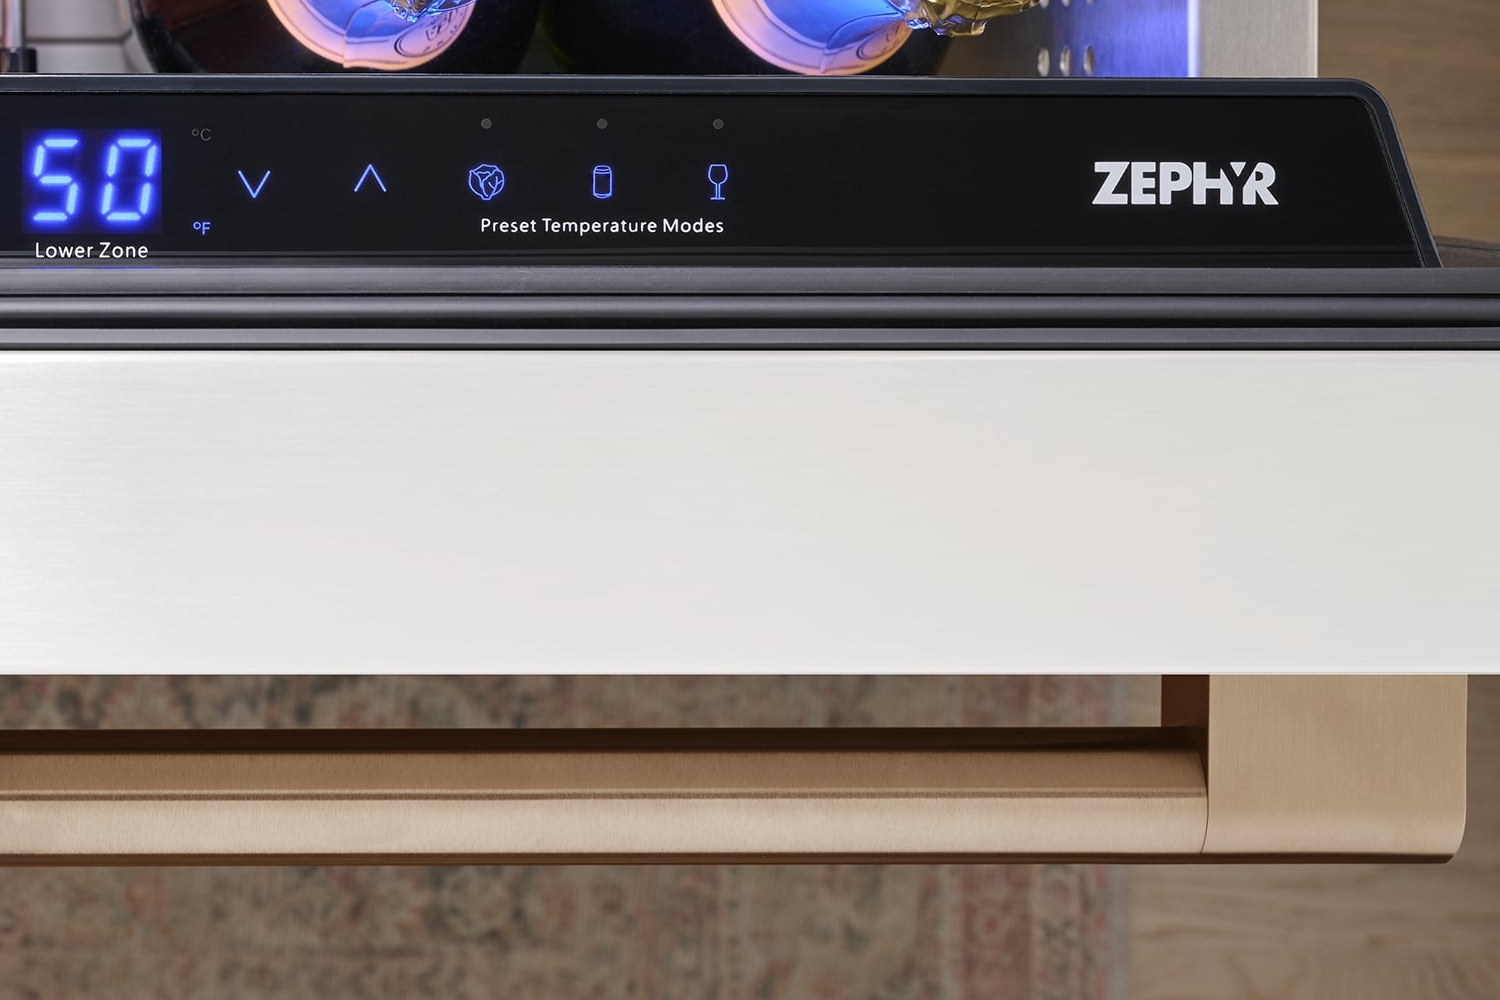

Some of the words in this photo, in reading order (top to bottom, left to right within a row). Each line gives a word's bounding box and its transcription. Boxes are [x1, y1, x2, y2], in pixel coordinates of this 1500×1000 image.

[191, 128, 212, 141] °C
[33, 138, 157, 222] 50
[1092, 161, 1279, 205] ZEPHYR
[193, 221, 211, 235] °F
[481, 217, 536, 233] Preset
[542, 217, 658, 236] Temperature
[663, 217, 724, 233] Modes
[35, 242, 94, 258] Lower
[99, 242, 149, 258] Zone
